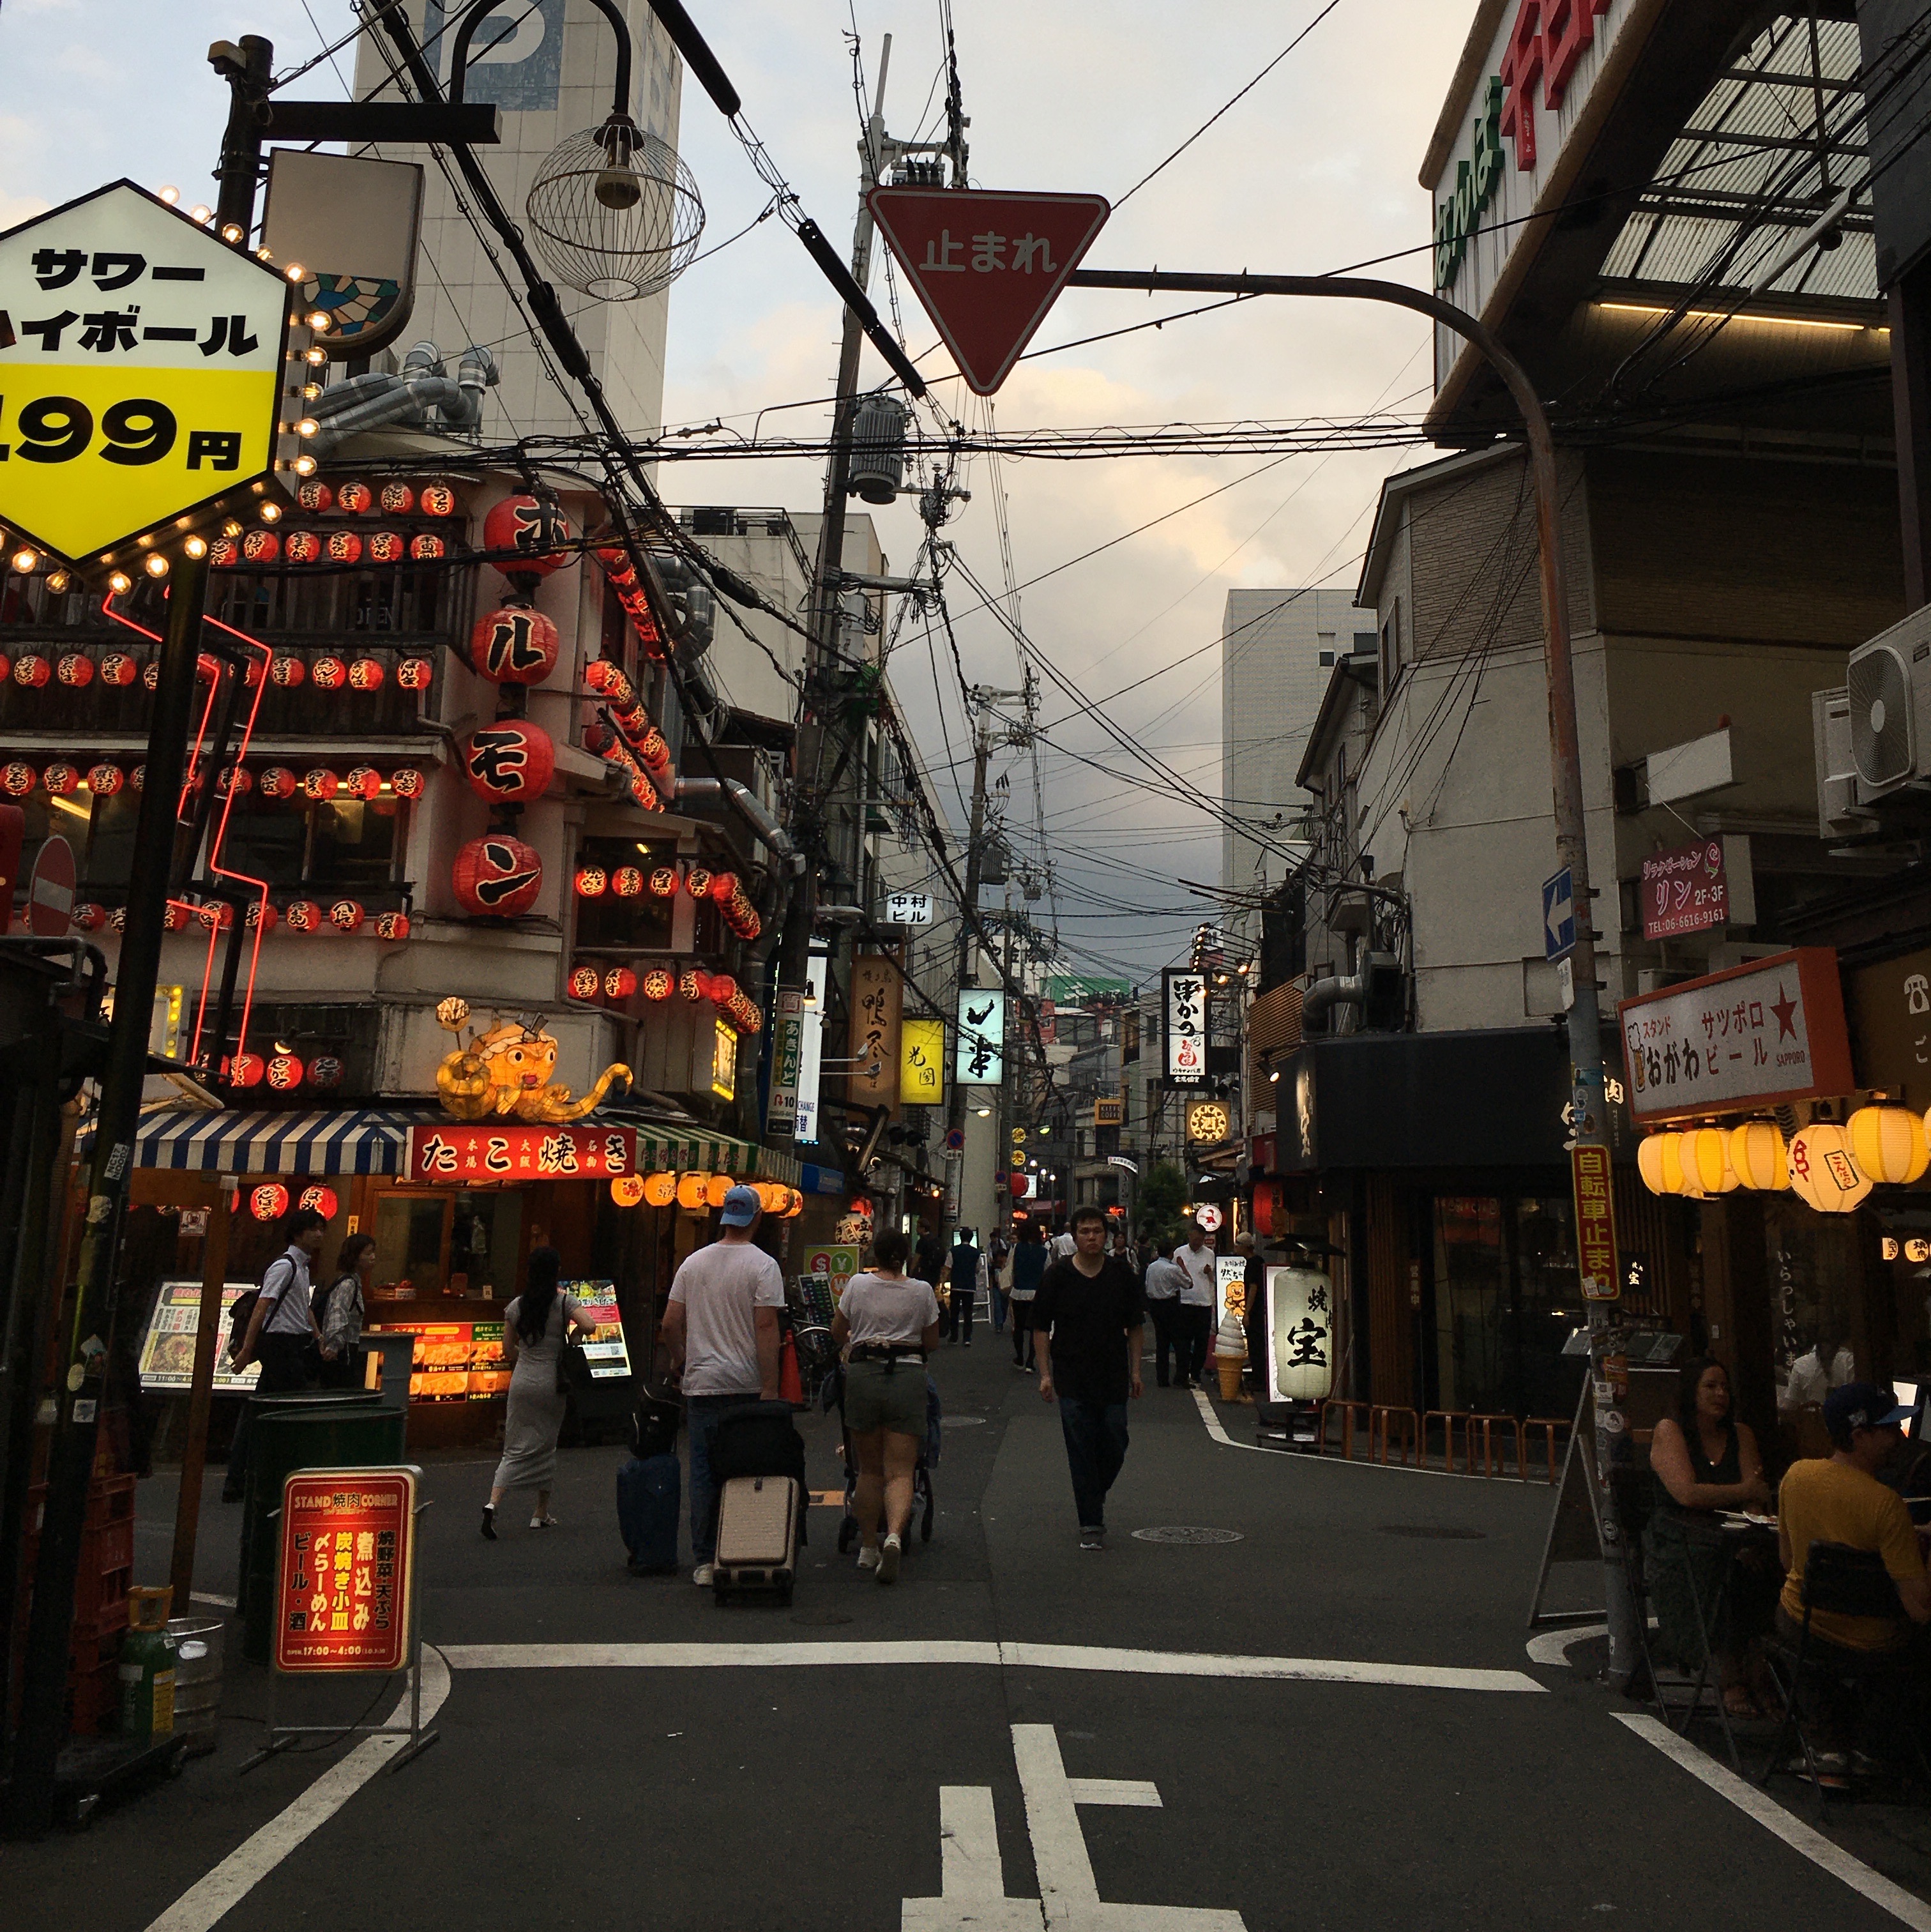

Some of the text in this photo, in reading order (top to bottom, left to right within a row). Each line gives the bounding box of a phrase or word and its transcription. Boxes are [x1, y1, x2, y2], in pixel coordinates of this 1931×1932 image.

[31, 248, 206, 291] サワー
[919, 229, 1057, 275] 止まれ
[1644, 851, 1702, 880] リラクゼーション
[892, 895, 927, 908] 中村
[893, 910, 926, 922] ビル
[1656, 879, 1692, 916] リン
[1174, 979, 1201, 1037] 串かつ
[1642, 1015, 1671, 1039] スタンド
[782, 1022, 798, 1085] あきんど
[1646, 1037, 1768, 1087] おがわ ビール
[1776, 1050, 1805, 1067] SAPPORO
[785, 1096, 794, 1107] 10
[421, 1133, 628, 1174] たこ焼き
[519, 1139, 531, 1168] 大阪
[586, 1139, 598, 1168] 名物
[1287, 1317, 1328, 1367] 宝
[294, 1493, 398, 1508] STAND 焼肉 CORNER
[331, 1532, 352, 1631] 炭焼き小皿
[353, 1532, 374, 1630] 煮込み
